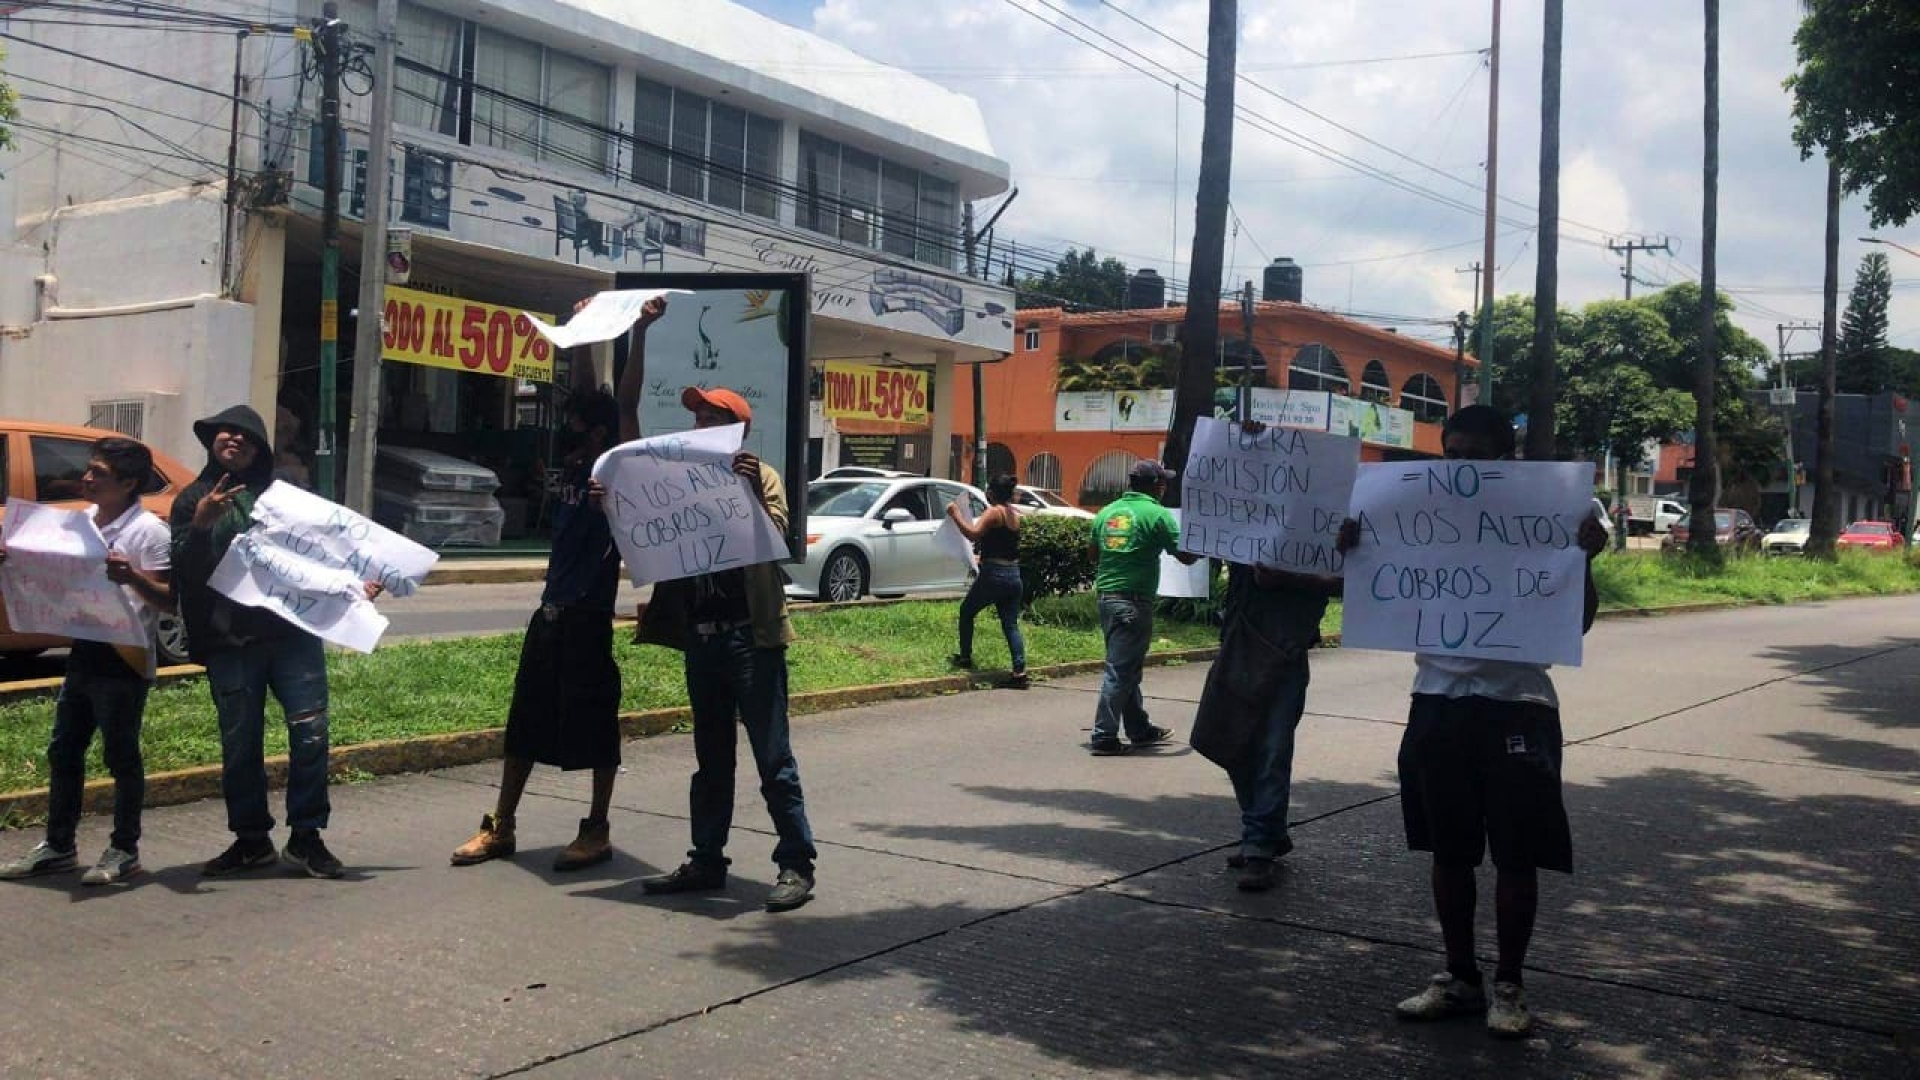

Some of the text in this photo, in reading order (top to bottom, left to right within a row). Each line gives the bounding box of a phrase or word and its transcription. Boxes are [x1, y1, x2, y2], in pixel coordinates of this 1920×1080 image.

[383, 299, 550, 374] ODO AL 50%
[826, 370, 925, 419] TODO AL 50%
[1227, 422, 1309, 456] FUERA
[1186, 452, 1310, 496] COMISIÓN
[614, 491, 637, 517] A
[641, 477, 685, 509] LOS
[1186, 487, 1343, 535] FEDERAL DE
[321, 509, 371, 541] NO
[631, 497, 749, 548] COBROS DE
[1358, 508, 1570, 550] A LOS ALTOS
[678, 534, 741, 575] LUZ
[1185, 522, 1344, 573] ELECTRICIDAD
[1371, 563, 1556, 602] COBROS DE
[1415, 608, 1522, 649] LUZ
